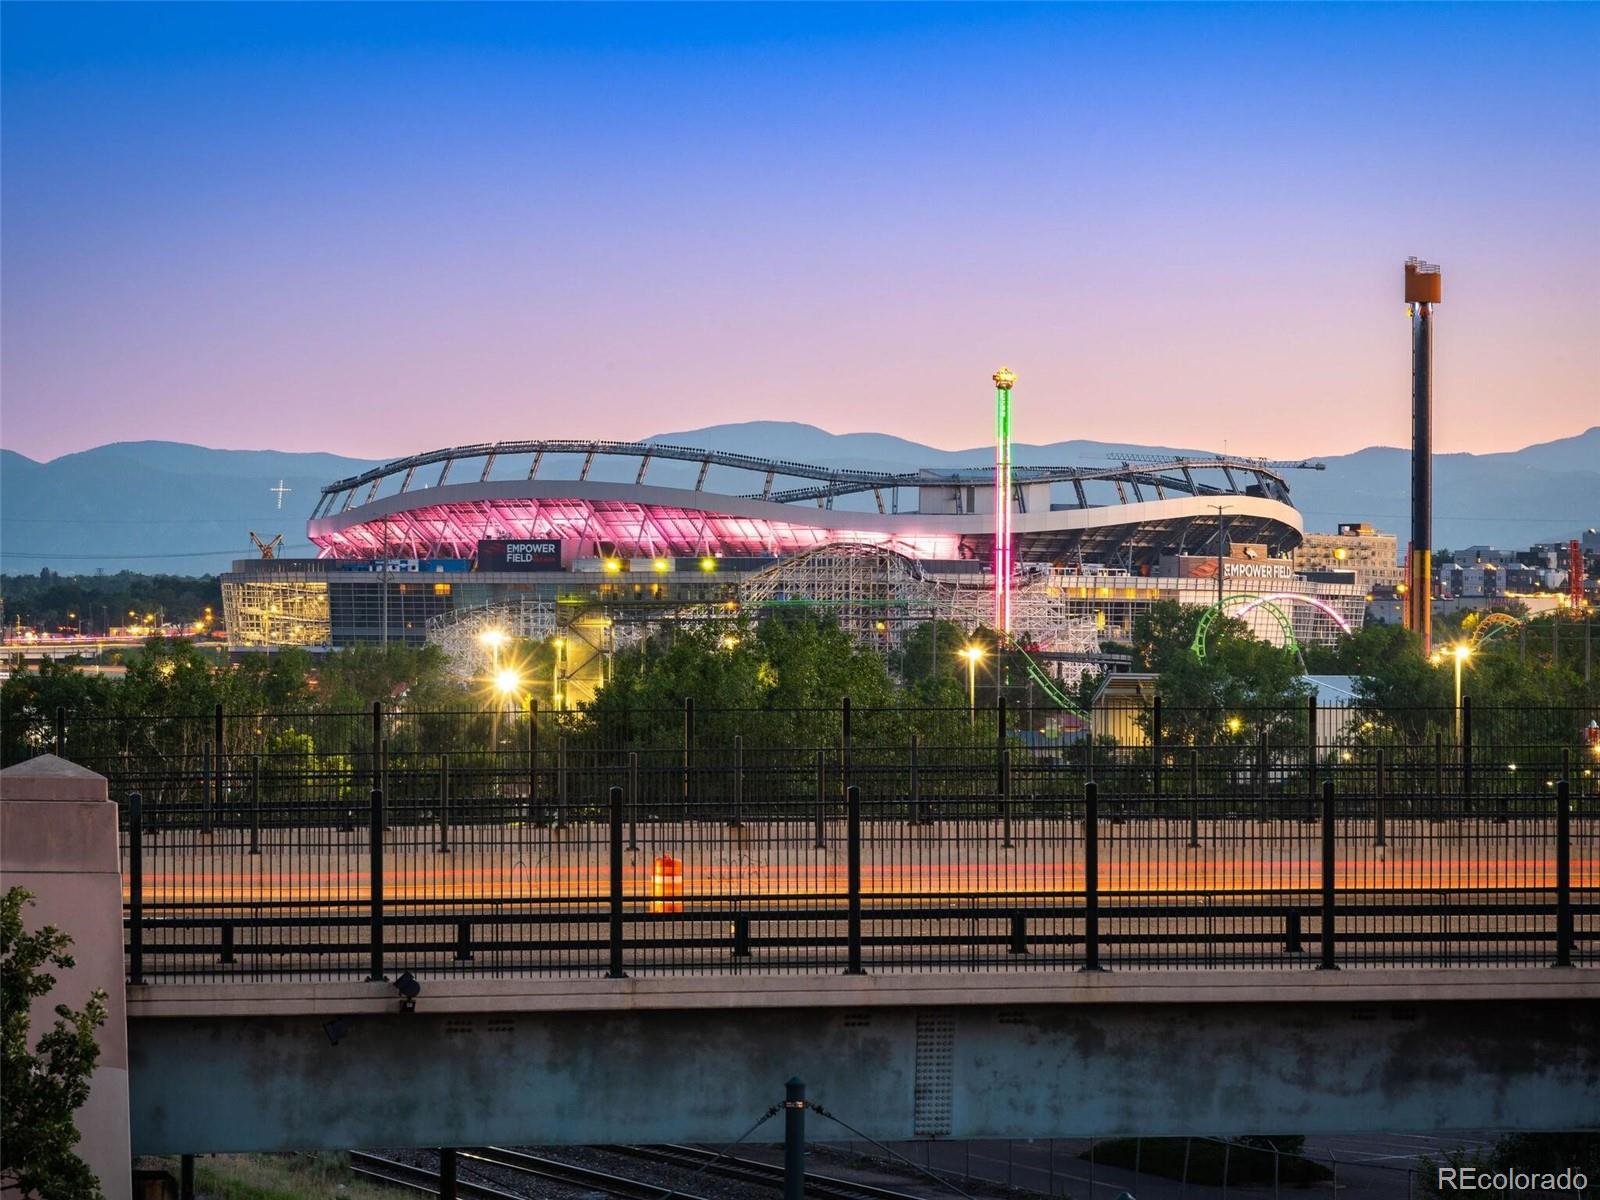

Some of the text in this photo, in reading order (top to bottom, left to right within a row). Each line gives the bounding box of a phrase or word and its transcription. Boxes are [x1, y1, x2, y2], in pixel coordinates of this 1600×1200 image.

[506, 543, 556, 553] EMPOWER
[506, 553, 533, 562] FIELD
[1223, 563, 1292, 579] EMPOWER FIELD
